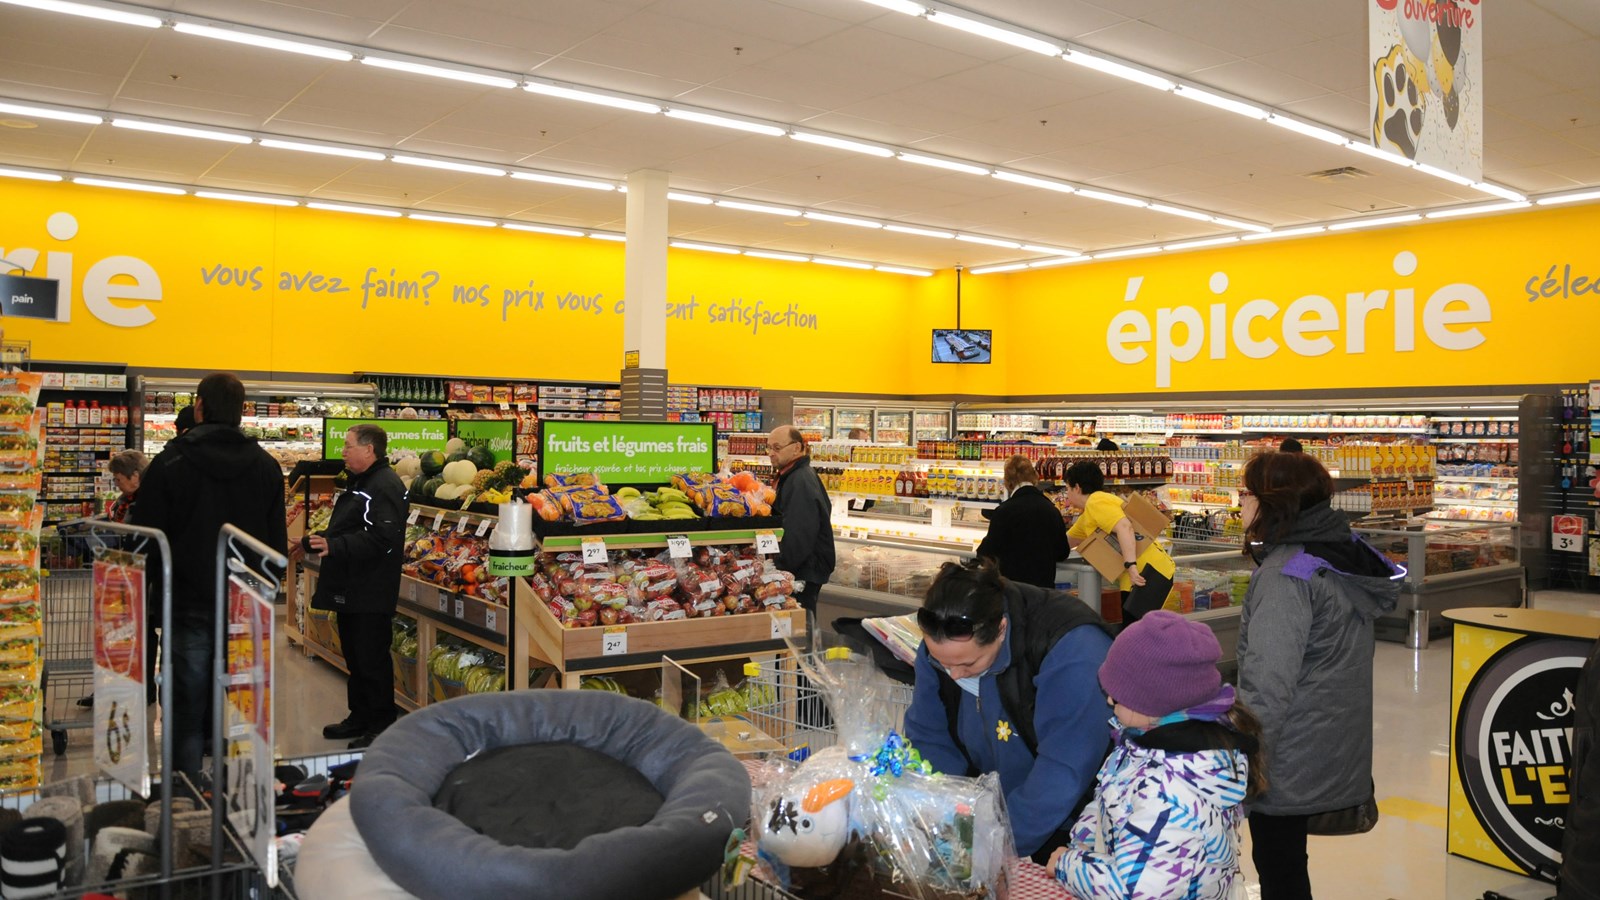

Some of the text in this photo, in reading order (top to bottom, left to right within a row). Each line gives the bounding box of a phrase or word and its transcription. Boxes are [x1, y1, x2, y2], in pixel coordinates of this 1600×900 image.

[1403, 0, 1474, 29] ouverture
[11, 293, 33, 305] pain
[201, 263, 818, 335] vous avez faim? nos prix vous oent satisfaction
[1106, 250, 1492, 388] épicerie
[386, 430, 420, 442] gumes
[422, 429, 445, 440] frais
[548, 434, 708, 457] fruits et légumes frais
[555, 463, 591, 474] fraîcheur
[593, 463, 621, 473] assurée
[623, 464, 633, 473] et
[635, 464, 646, 473] bas
[648, 463, 661, 477] prix
[492, 561, 528, 571] fraîcheur
[1492, 727, 1573, 766] FAIT
[1501, 765, 1571, 805] L'E
